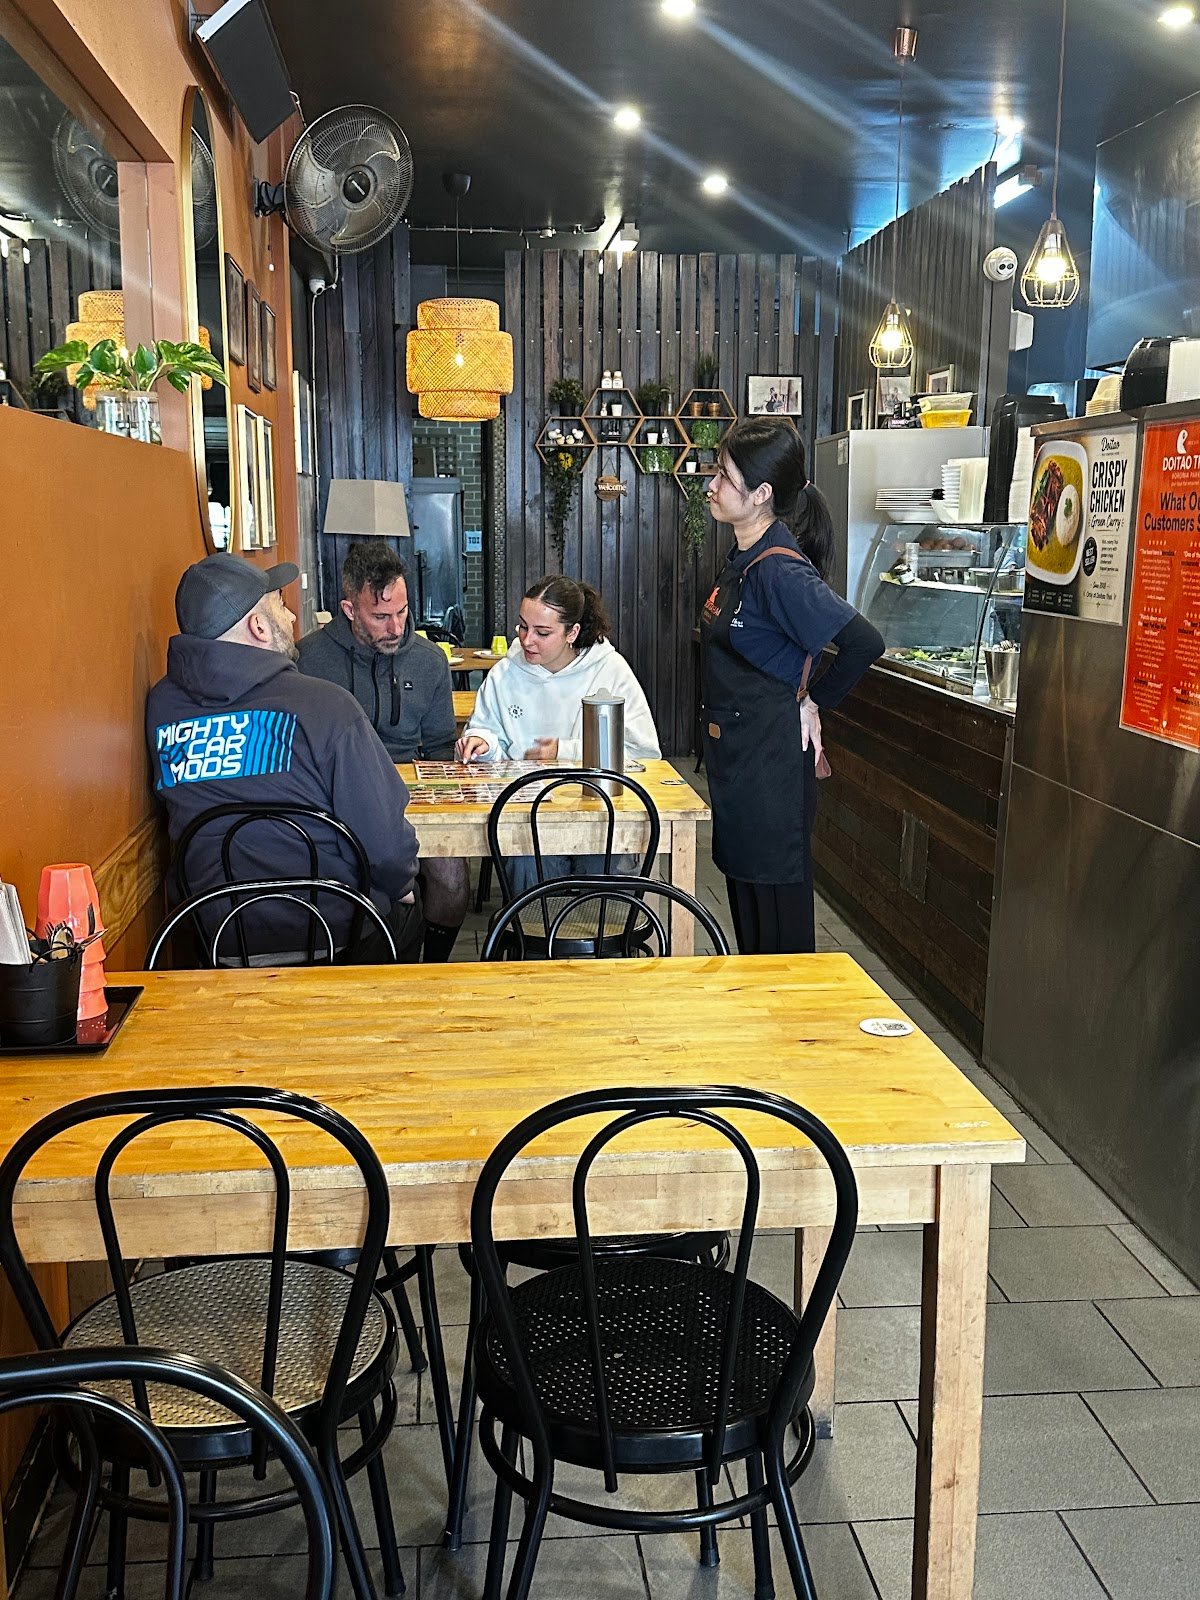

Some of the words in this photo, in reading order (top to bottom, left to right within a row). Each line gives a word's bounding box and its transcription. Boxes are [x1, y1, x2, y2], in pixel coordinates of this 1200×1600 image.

[1092, 459, 1128, 488] CRISPY
[1162, 455, 1192, 471] DOITAO
[598, 483, 627, 491] welcome
[1089, 489, 1126, 513] CHICKEN
[1160, 492, 1187, 511] What
[1090, 514, 1106, 529] Green
[1106, 513, 1122, 532] Curry
[1144, 512, 1194, 532] Customers
[157, 713, 250, 749] MIGHTY
[187, 733, 246, 760] CAR
[170, 753, 243, 784] MODS
